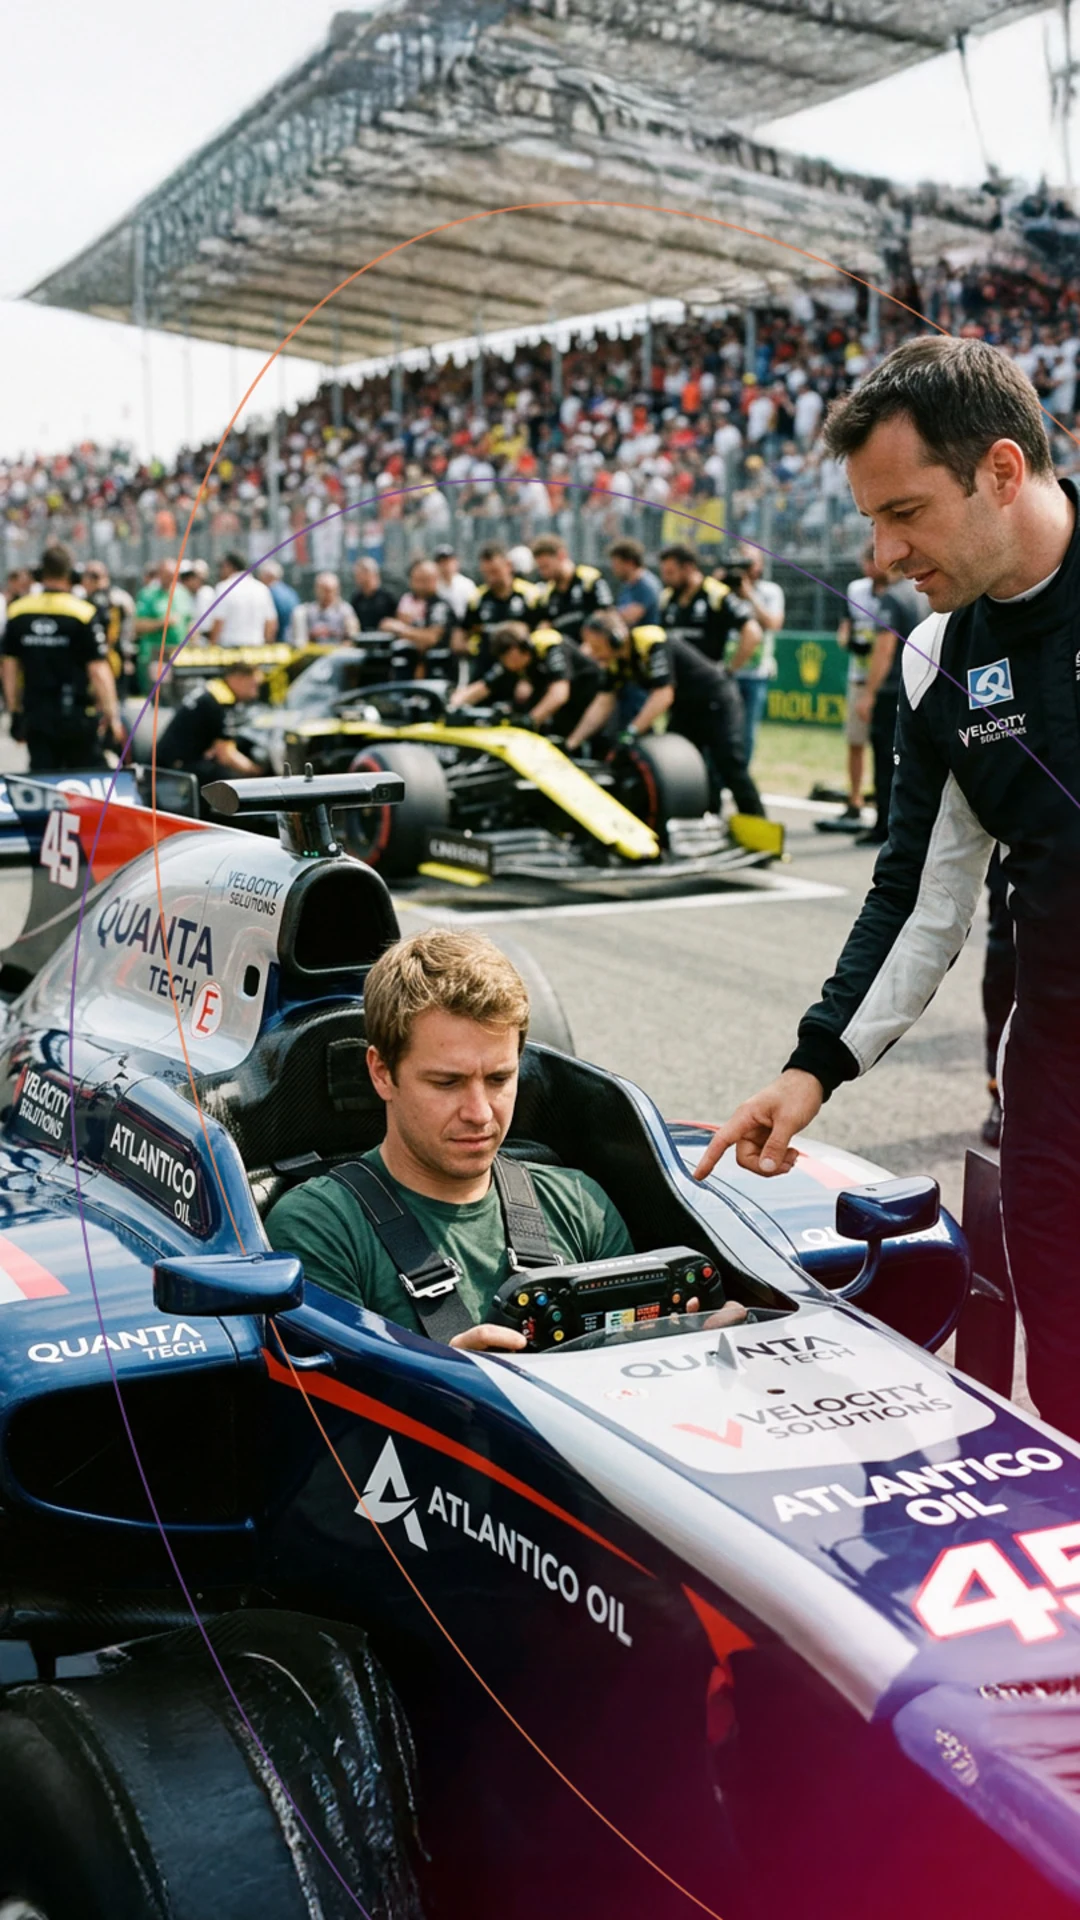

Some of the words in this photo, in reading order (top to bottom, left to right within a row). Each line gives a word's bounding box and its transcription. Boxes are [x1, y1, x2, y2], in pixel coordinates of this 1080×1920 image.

[959, 713, 1027, 748] VELOCITY
[40, 809, 81, 890] 45
[227, 871, 284, 900] VELOCITY
[97, 897, 214, 976] QUANTA
[149, 964, 197, 1007] TECH
[196, 990, 219, 1033] E
[22, 1070, 72, 1118] VELOCITY
[110, 1122, 197, 1200] ATLANTICO
[174, 1199, 192, 1228] OIL
[27, 1322, 203, 1364] QUANTA
[142, 1339, 208, 1361] TECH
[773, 1346, 857, 1367] TECH
[736, 1382, 930, 1426] VELOCITY
[765, 1397, 953, 1440] SOLUTIONS
[772, 1447, 1064, 1523] ATLANTICO
[905, 1490, 1010, 1526] OIL
[427, 1485, 580, 1604] ATLANTICO
[586, 1584, 633, 1648] OIL
